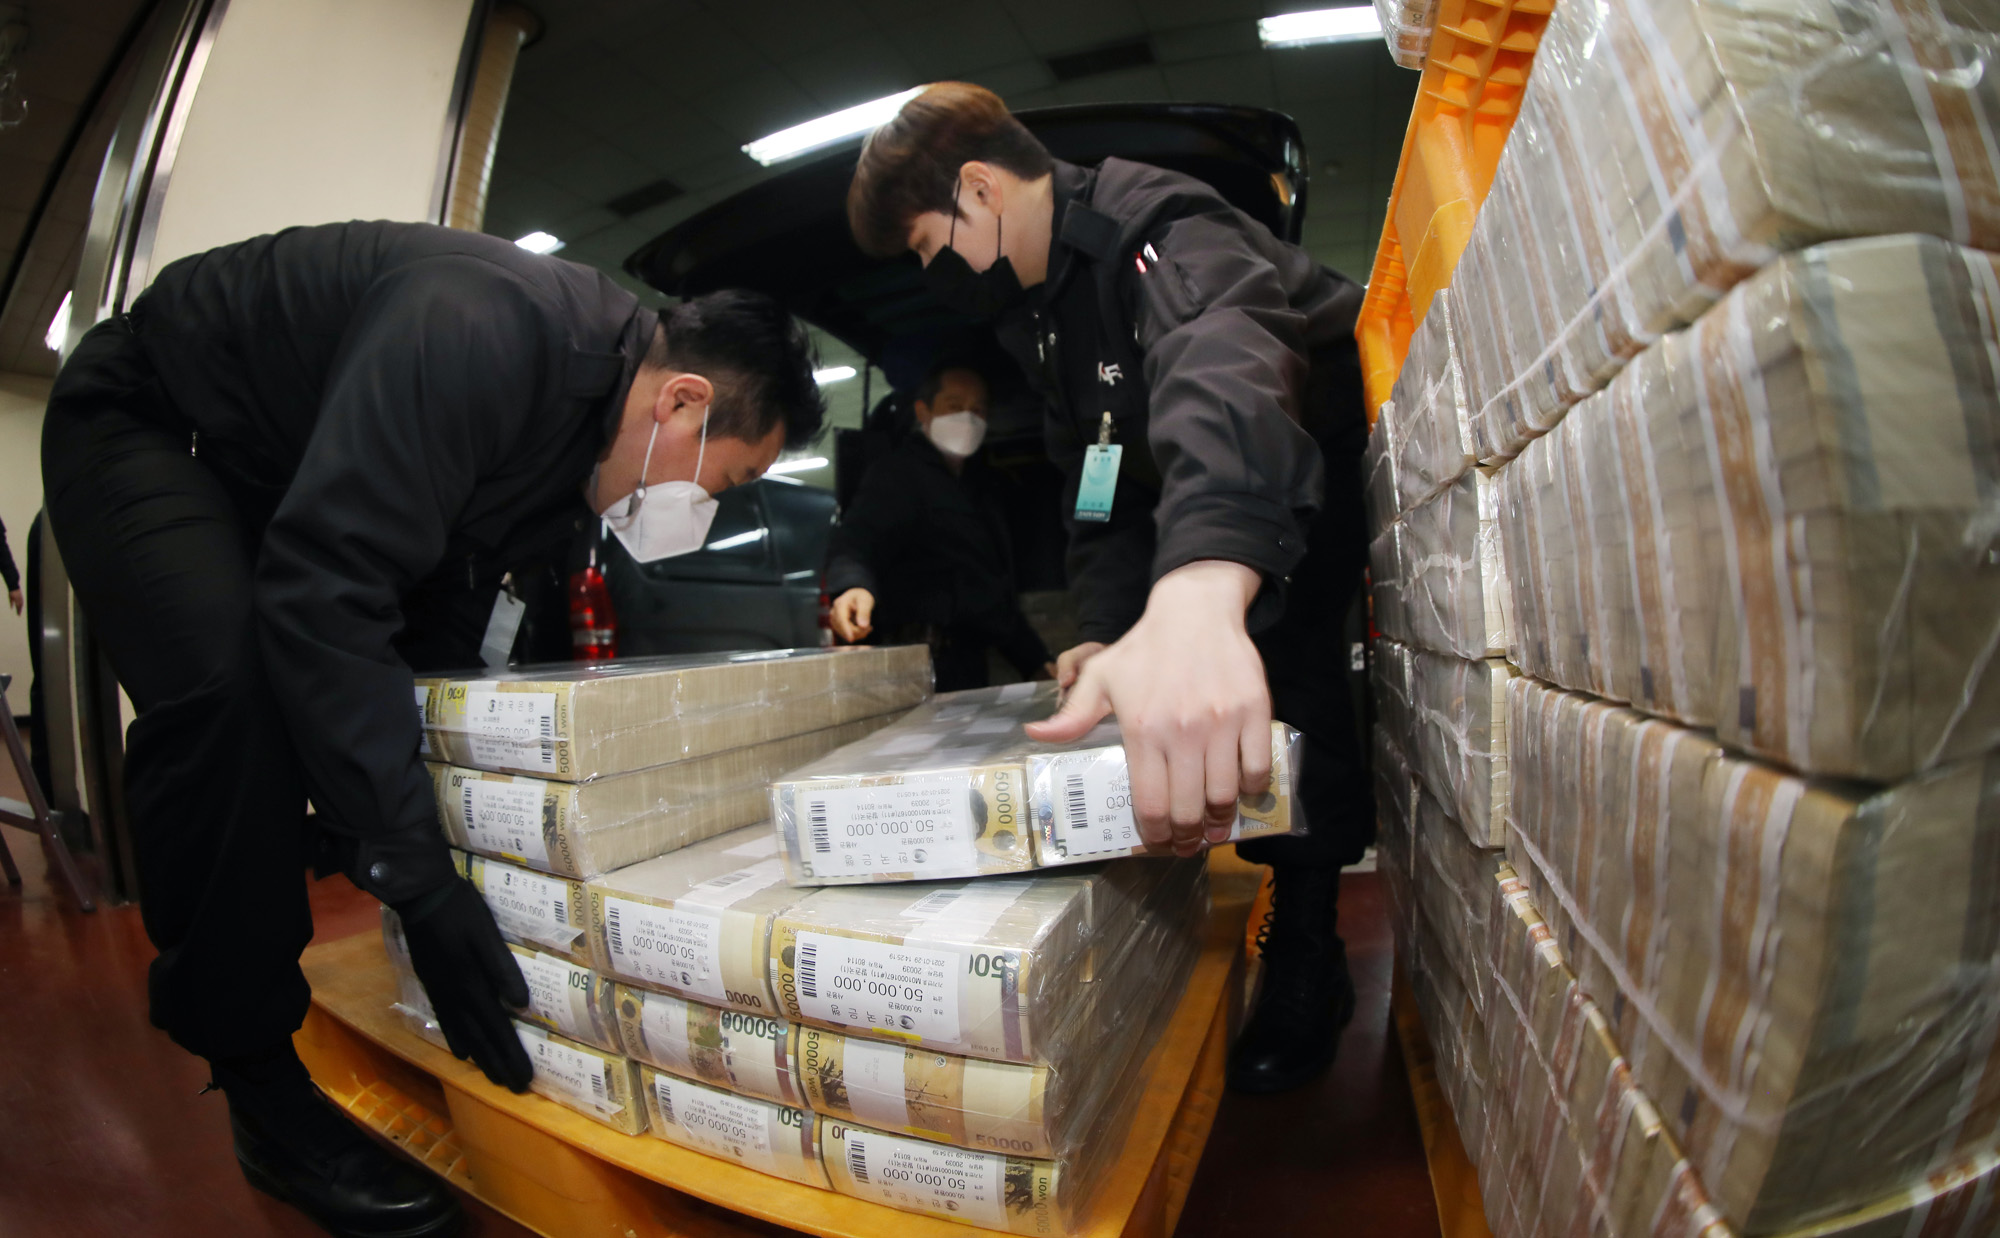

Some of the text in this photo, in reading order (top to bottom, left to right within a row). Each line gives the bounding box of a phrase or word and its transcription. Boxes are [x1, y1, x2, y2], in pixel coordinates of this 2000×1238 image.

[994, 770, 1013, 825] 50000
[856, 803, 875, 811] 80114
[846, 818, 934, 837] 50,000,000
[558, 834, 574, 871] 50000
[571, 882, 583, 926] 50000
[632, 935, 695, 960] 50,000,000
[847, 956, 866, 966] 80114
[902, 965, 922, 974] 20039
[914, 956, 945, 967] 2021-01-29
[840, 965, 868, 977] 발권국(1)
[870, 969, 922, 984] M01000167(#11)
[781, 973, 800, 1019] 50000
[826, 991, 844, 1000] 사용권
[833, 975, 923, 1002] 50,000,000
[888, 1002, 922, 1013] 50,000원권
[721, 1011, 779, 1041] 50000
[807, 1032, 819, 1098] 50000 won
[684, 1111, 746, 1138] 50,000,000
[975, 1134, 1034, 1152] 50000
[893, 1151, 911, 1161] 80114
[945, 1160, 964, 1169] 20039
[955, 1152, 985, 1161] 2021-01-29
[883, 1167, 966, 1190] 50,000,000
[916, 1163, 964, 1176] M01000167(#11)
[1038, 1177, 1047, 1201] won
